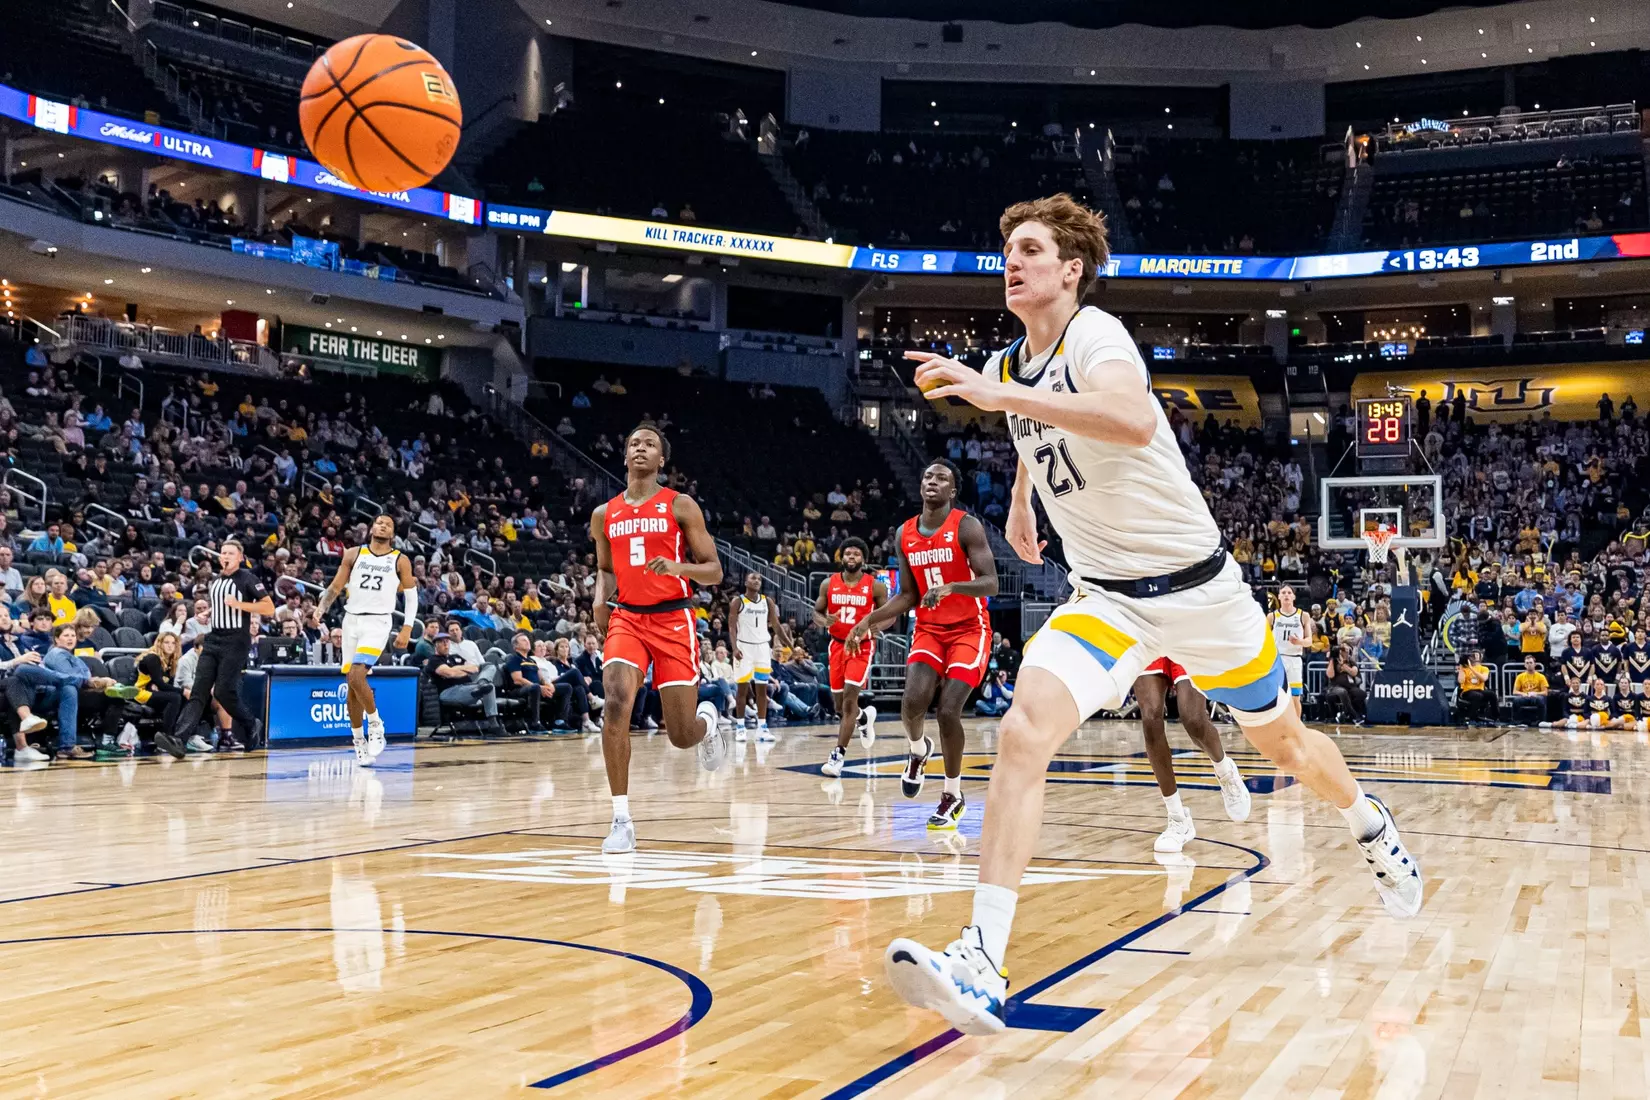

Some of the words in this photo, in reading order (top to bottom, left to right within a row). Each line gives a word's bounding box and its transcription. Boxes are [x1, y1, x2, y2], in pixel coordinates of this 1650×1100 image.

[163, 135, 213, 159] ULTRA
[519, 214, 540, 228] PM
[645, 226, 669, 241] KILL
[672, 229, 727, 248] TRACKER:
[729, 236, 775, 253] XXXXXX
[871, 252, 900, 269] FLS
[922, 253, 938, 271] 2
[976, 255, 1005, 271] TOL
[1139, 258, 1243, 275] MARQUETTE
[1530, 239, 1579, 262] 2nd
[309, 332, 349, 357] FEAR
[352, 339, 379, 361] THE
[382, 343, 418, 367] DEER
[1367, 402, 1403, 418] 13:43
[1367, 417, 1400, 443] 28
[1033, 437, 1087, 498] 21
[609, 518, 668, 539] RADFORD
[629, 536, 646, 567] 5
[907, 547, 954, 567] RADFORD
[360, 574, 383, 591] 23
[923, 566, 945, 590] 15
[831, 593, 867, 606] RADFORD
[755, 616, 759, 628] 1
[840, 606, 857, 624] 12
[1374, 679, 1434, 704] meijer
[311, 703, 351, 723] GRU
